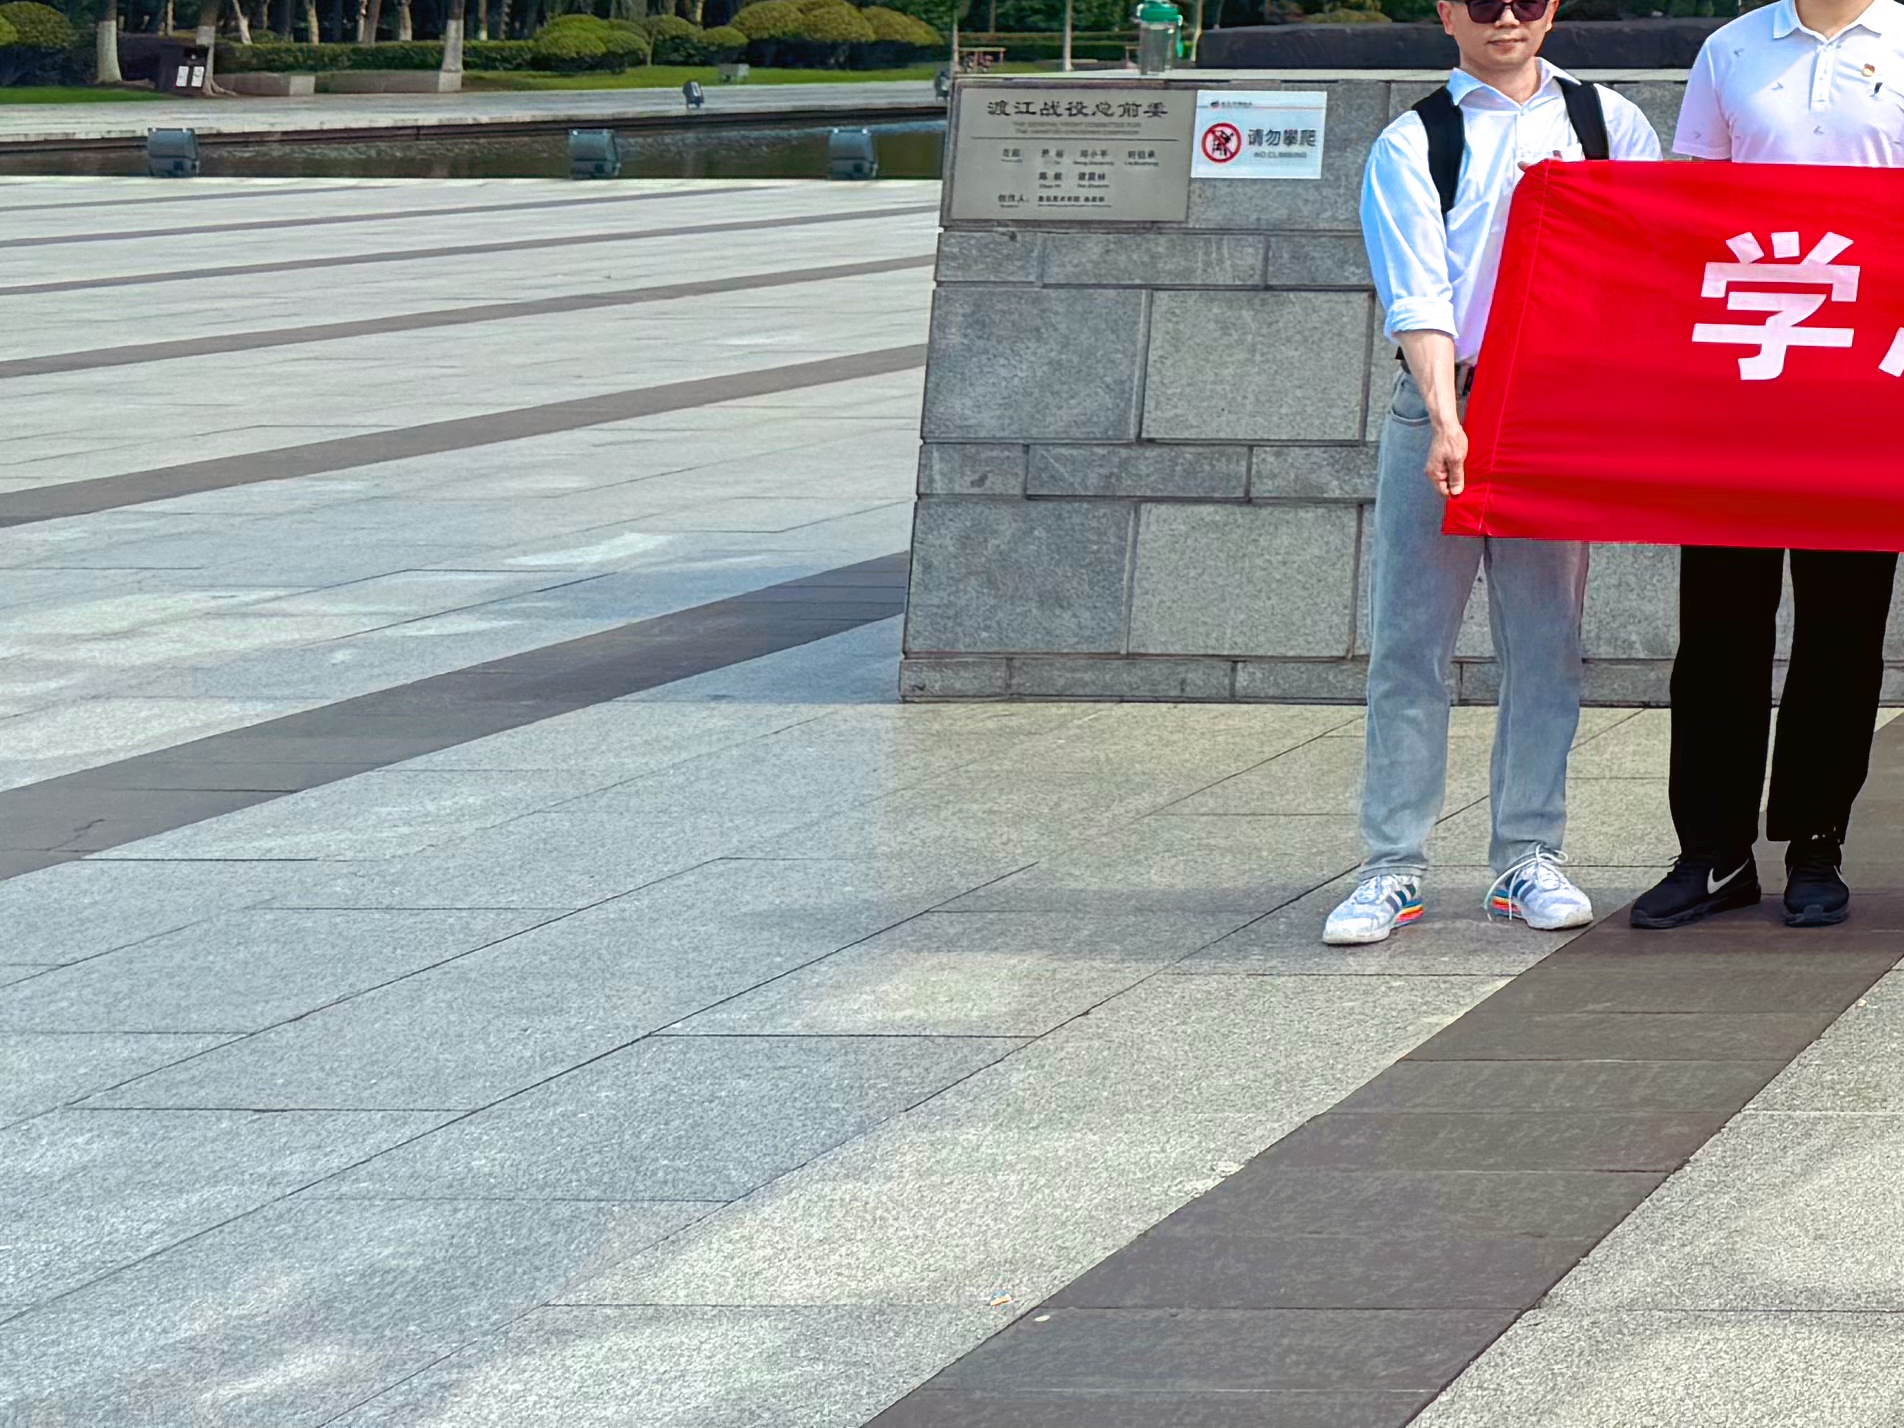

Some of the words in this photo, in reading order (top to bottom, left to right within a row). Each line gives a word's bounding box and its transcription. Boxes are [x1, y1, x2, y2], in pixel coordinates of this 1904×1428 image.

[986, 99, 1169, 118] 渡江战役总前委
[1247, 128, 1317, 147] 请勿攀爬
